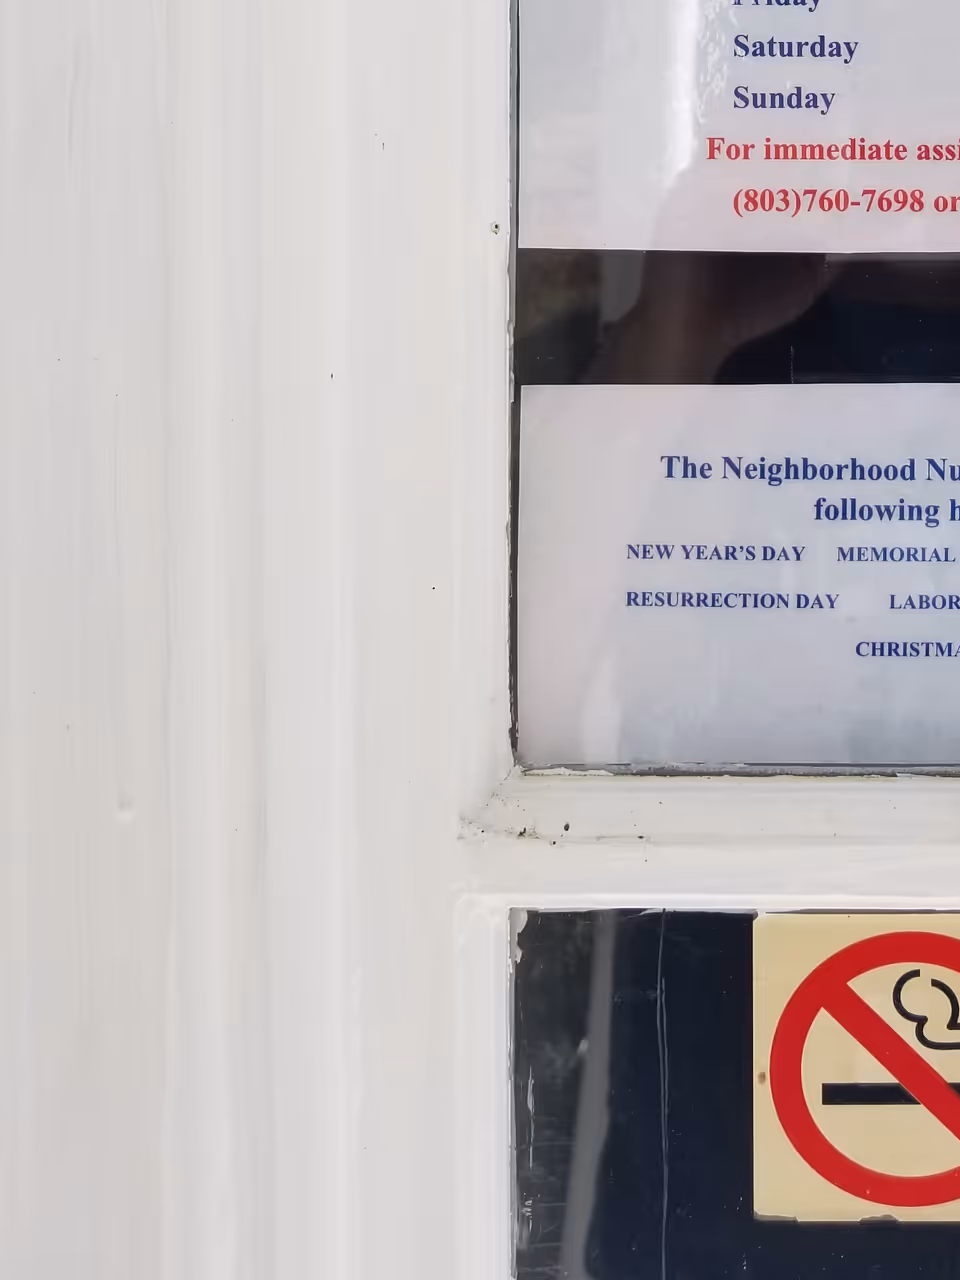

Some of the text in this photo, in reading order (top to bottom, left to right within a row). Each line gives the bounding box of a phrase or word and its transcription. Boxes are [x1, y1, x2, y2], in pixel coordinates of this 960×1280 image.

[733, 33, 859, 64] Saturday
[733, 85, 835, 115] Sunday
[705, 136, 755, 160] For
[763, 136, 907, 160] immediate
[732, 188, 924, 217] (803)760-7698
[659, 455, 712, 479] The
[721, 456, 916, 486] Neighborhood
[813, 496, 940, 528] following
[626, 543, 675, 559] NEW
[761, 545, 805, 561] DAY
[836, 546, 956, 562] MEMORIAL
[625, 591, 839, 608] RESURRECTION DAY
